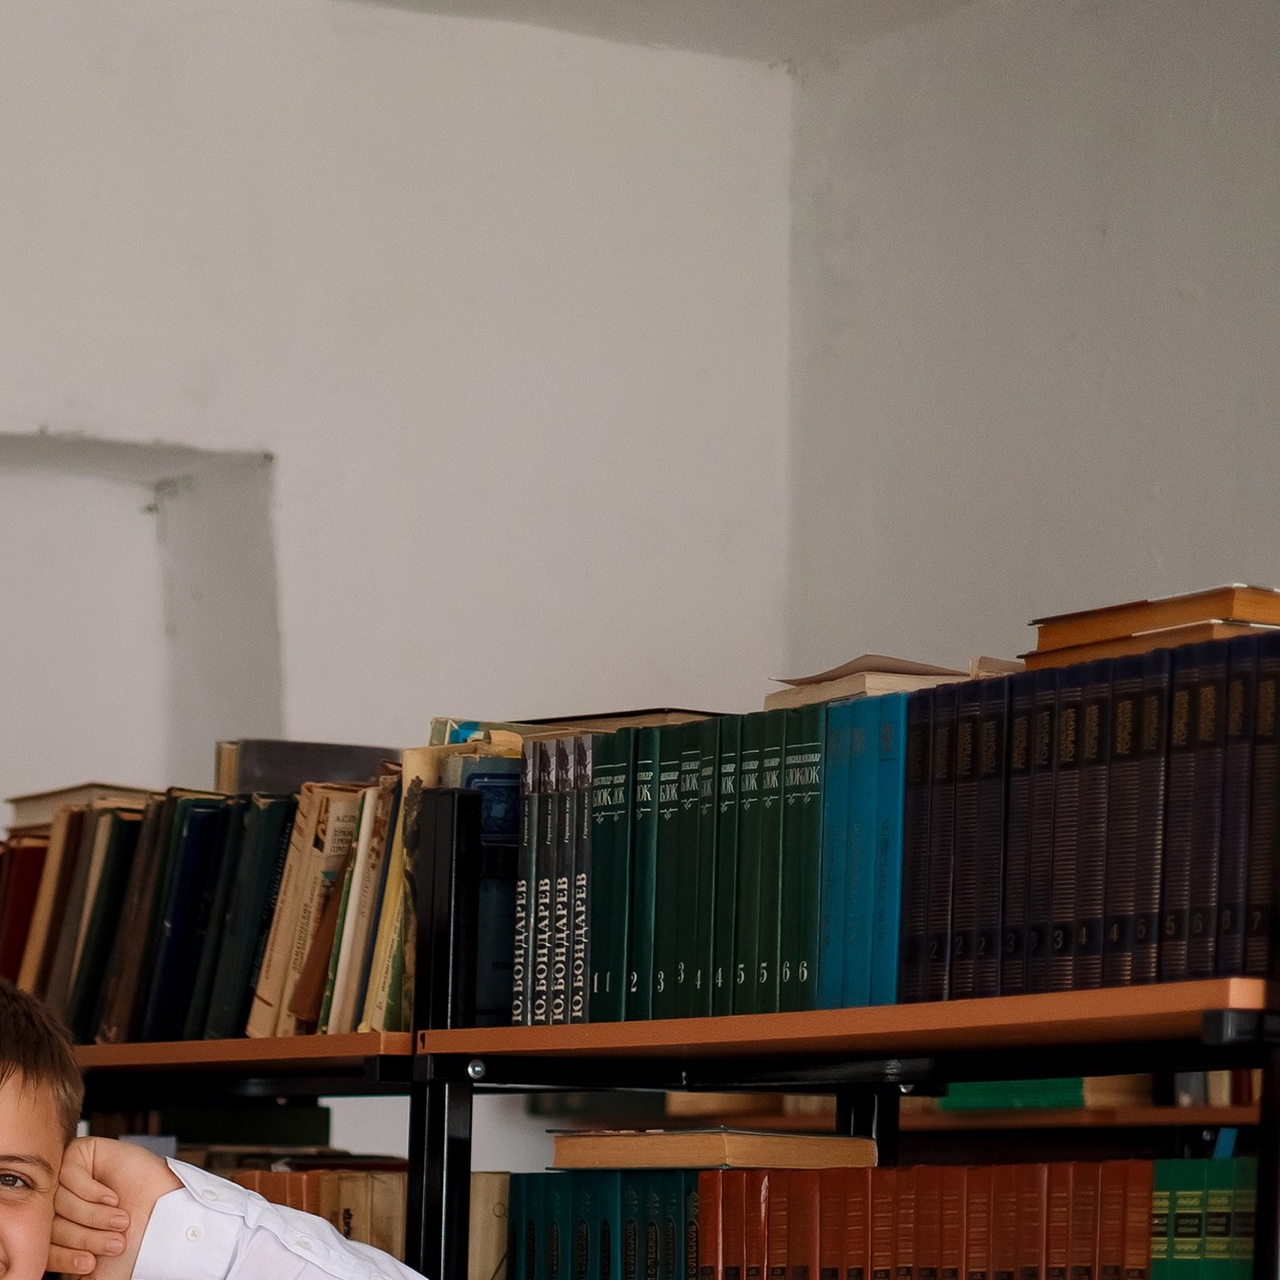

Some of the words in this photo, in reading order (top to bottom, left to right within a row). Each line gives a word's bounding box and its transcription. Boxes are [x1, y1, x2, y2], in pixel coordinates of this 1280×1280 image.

[512, 879, 528, 992] БОНДАРЕВ
[535, 877, 552, 992] БОНДАРЕВ
[552, 876, 570, 991] БОНДАРЕВ
[573, 872, 589, 987] БОНДАРЕВ
[511, 996, 523, 1022] Ю.
[533, 995, 546, 1022] Ю.
[551, 995, 565, 1022] Ю.
[571, 991, 584, 1018] Ю.
